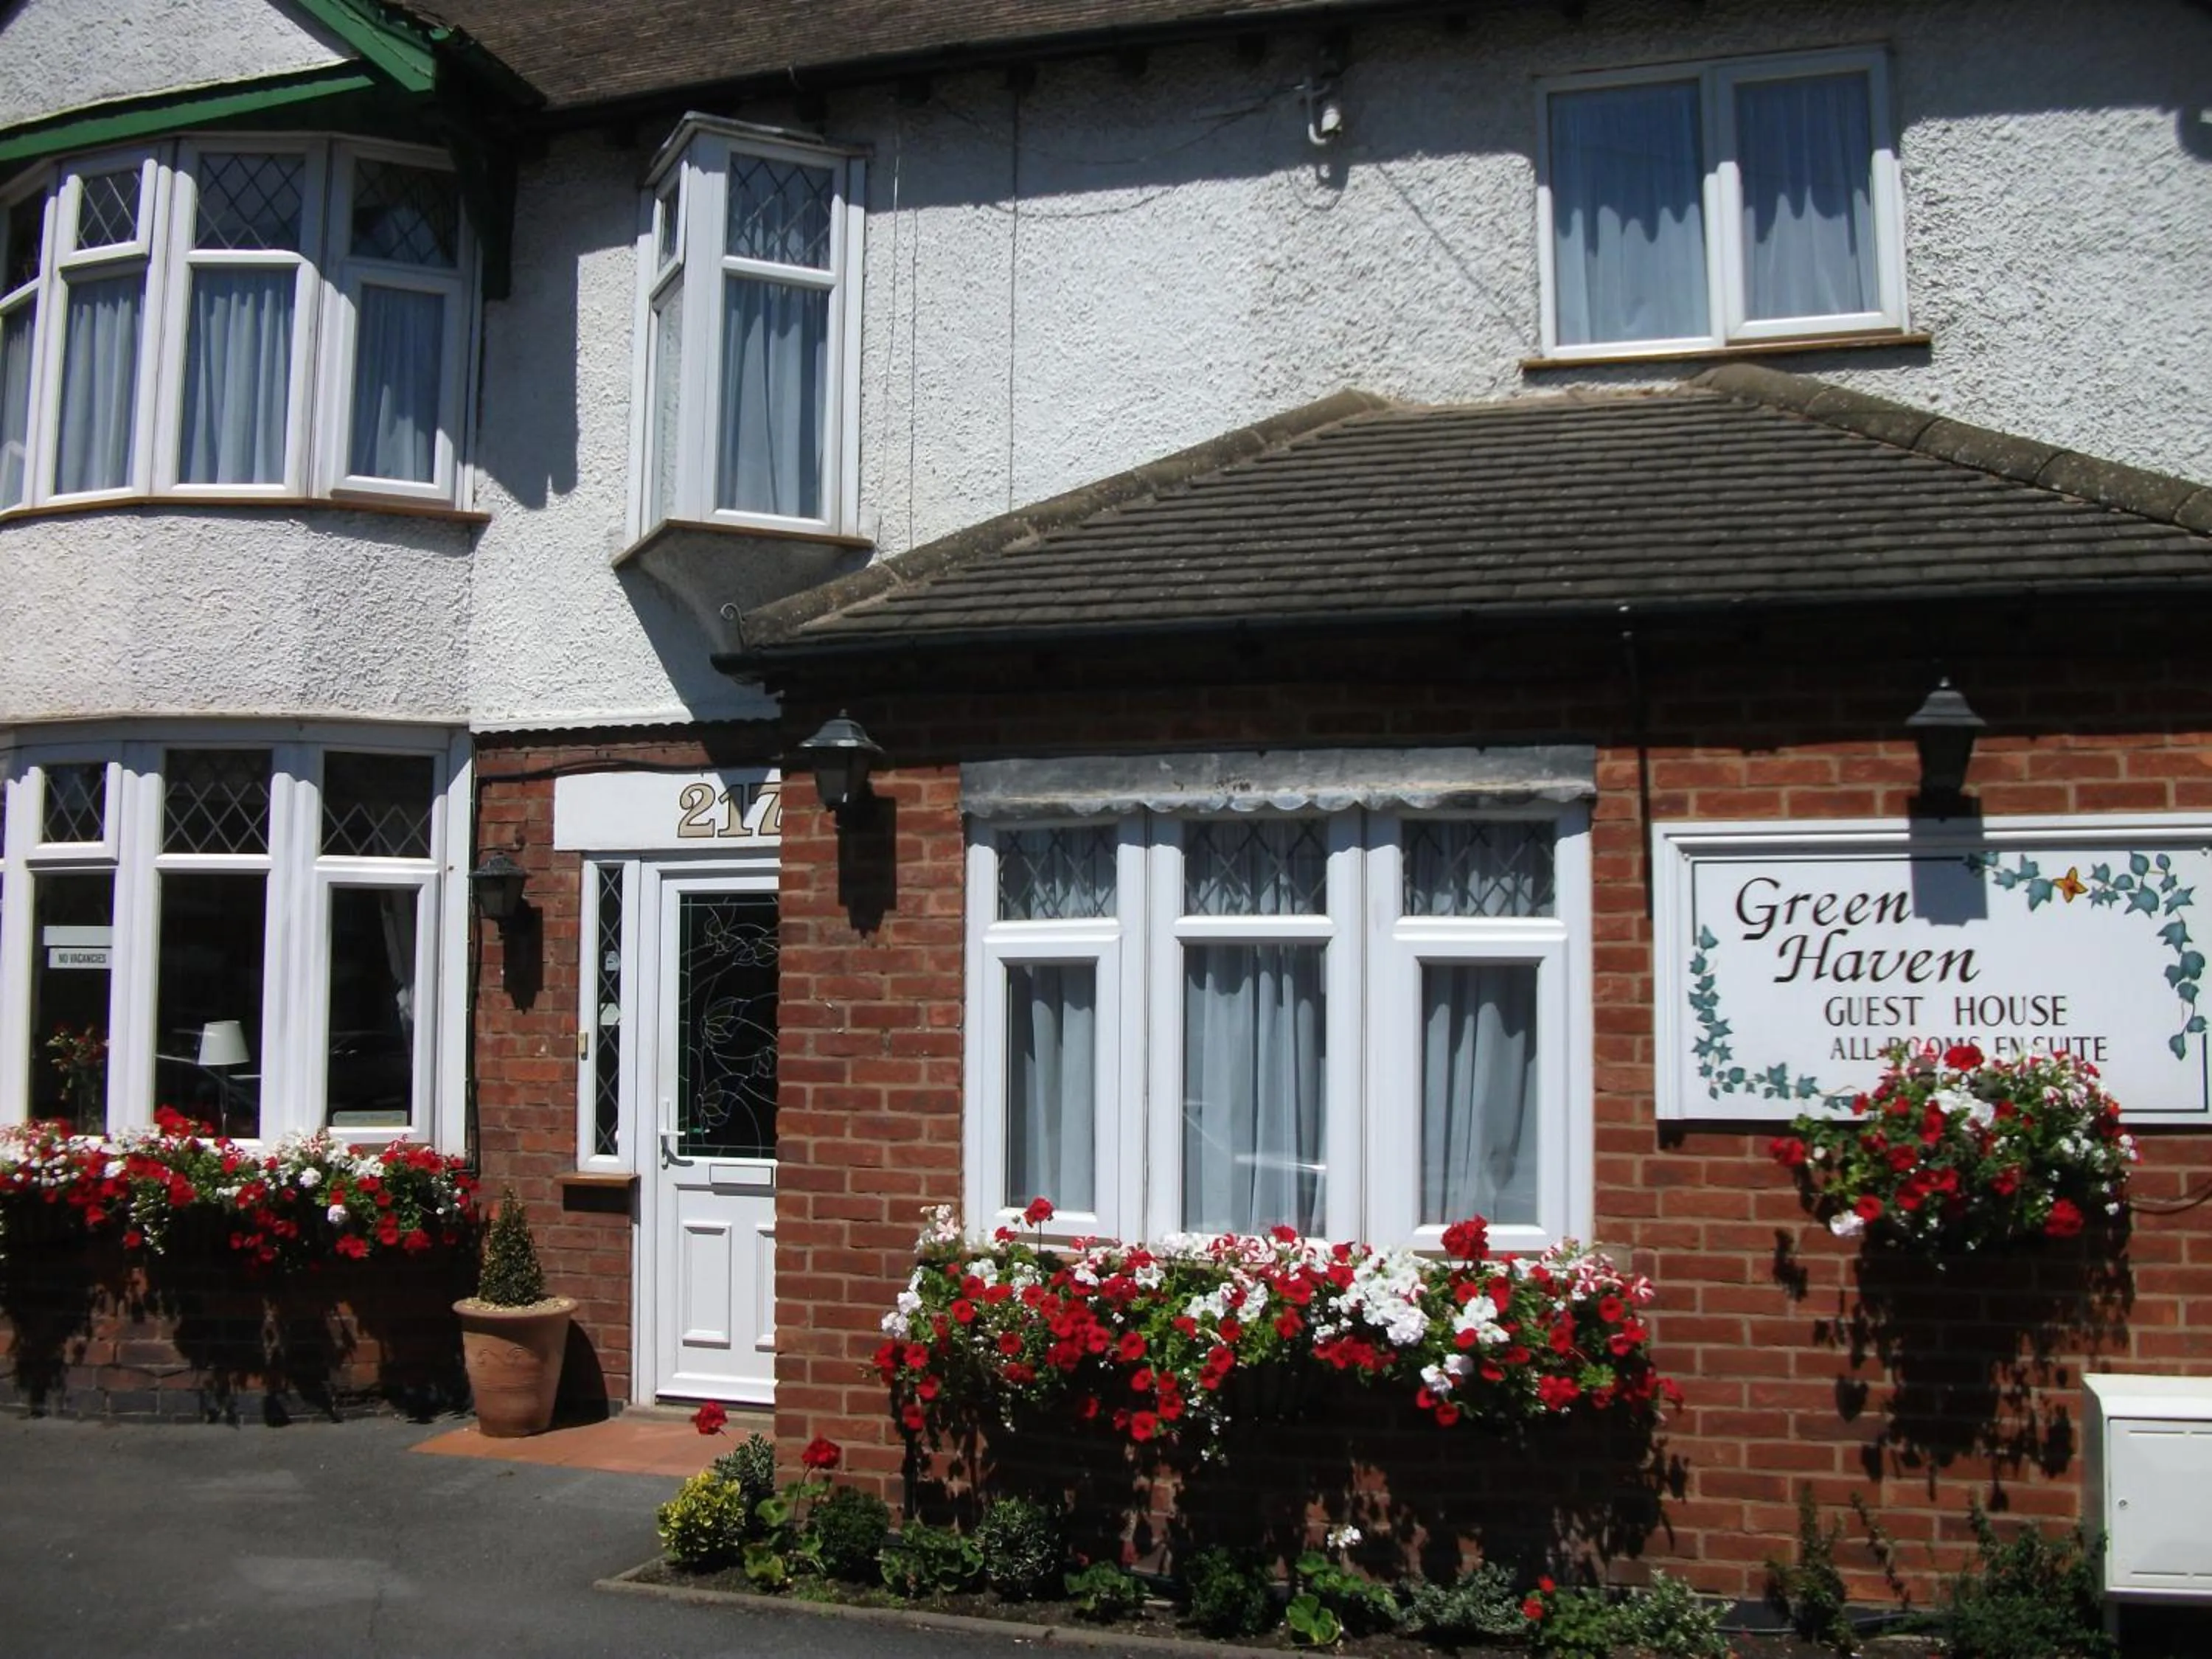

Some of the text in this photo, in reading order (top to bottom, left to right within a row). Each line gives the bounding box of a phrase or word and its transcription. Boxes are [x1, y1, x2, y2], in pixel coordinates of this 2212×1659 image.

[677, 782, 781, 838] 217
[1735, 877, 1912, 940] Green
[1773, 928, 1980, 983] Haven
[1824, 995, 2067, 1026] GUEST HOUSE
[1829, 1037, 1877, 1060] ALL
